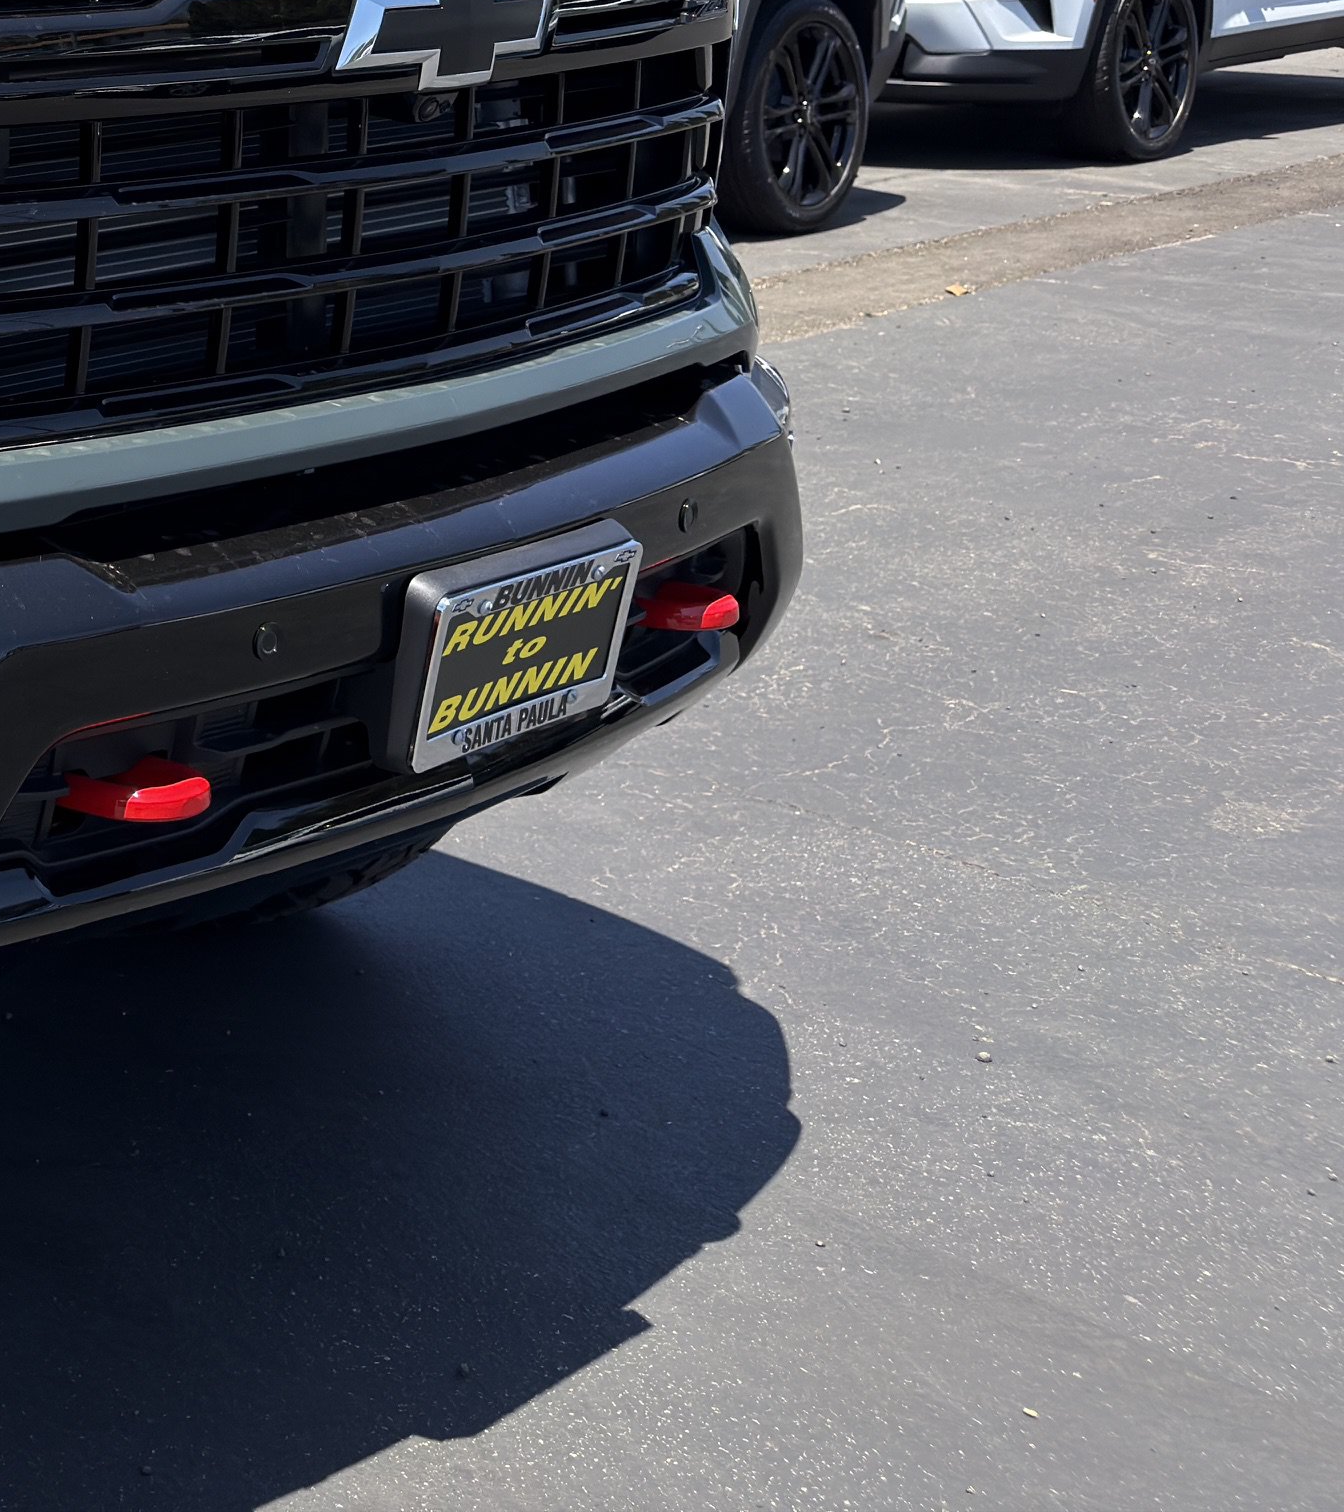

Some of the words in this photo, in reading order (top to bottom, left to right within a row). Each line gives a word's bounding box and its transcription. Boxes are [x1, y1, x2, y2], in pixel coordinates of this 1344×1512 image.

[490, 559, 595, 611] BUNNIN
[442, 576, 623, 657] RUNNIN'
[502, 635, 547, 665] to
[427, 647, 599, 735] BUNNIN
[461, 717, 512, 753] SANTA
[517, 693, 567, 732] PAULA
